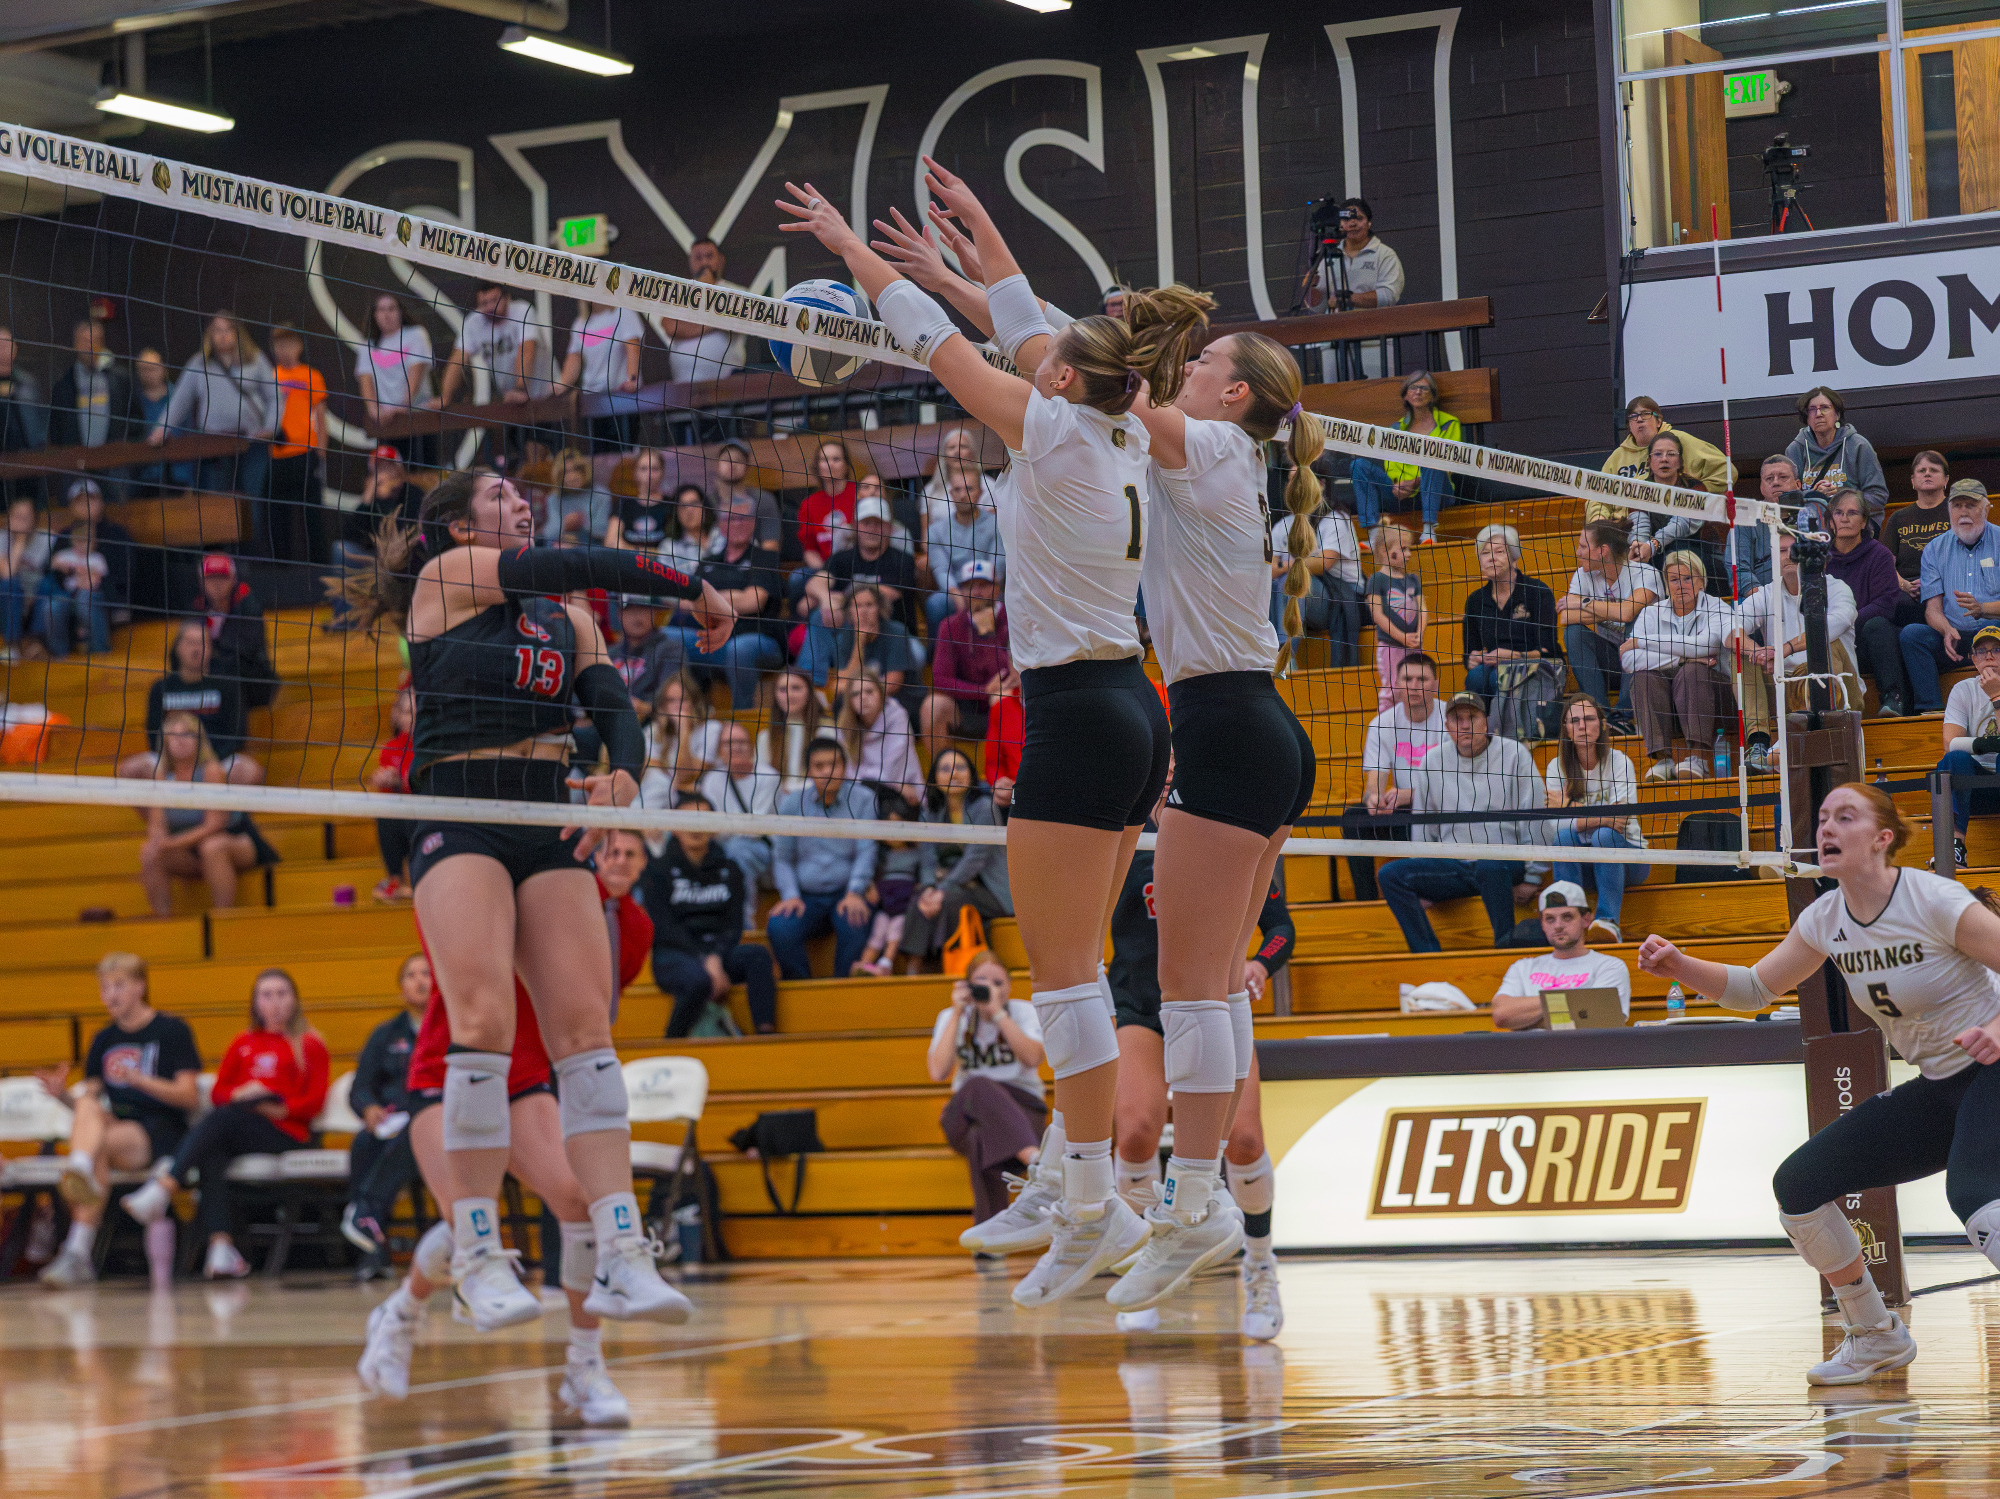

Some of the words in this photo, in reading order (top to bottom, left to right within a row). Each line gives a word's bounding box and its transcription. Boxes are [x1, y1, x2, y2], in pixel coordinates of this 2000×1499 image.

[1729, 73, 1767, 105] EXIT
[18, 131, 143, 185] VOLLEYBALL
[181, 167, 273, 215] MUSTANG
[277, 189, 386, 239] VOLLEYBALL
[420, 222, 501, 265] MUSTANG
[505, 242, 598, 288] VOLLEYBALL
[628, 272, 702, 310] MUSTANG
[705, 289, 789, 328] VOLLEYBALL
[814, 312, 880, 347] MUSTANG
[1380, 431, 1422, 455] MUSTANG
[1423, 437, 1472, 465] VOLLEYBALL
[1487, 453, 1526, 475] MUSTANG
[1527, 461, 1572, 485] VOLLEYBALL
[1585, 474, 1620, 496] MUSTANG
[1673, 492, 1706, 511] MUSTANG
[1123, 483, 1142, 561] 1
[1897, 521, 1950, 536] SOUTHWES
[514, 644, 566, 698] 13
[1831, 943, 1924, 974] MUSTANGS
[1867, 982, 1903, 1018] 5
[956, 1043, 1015, 1070] SMS
